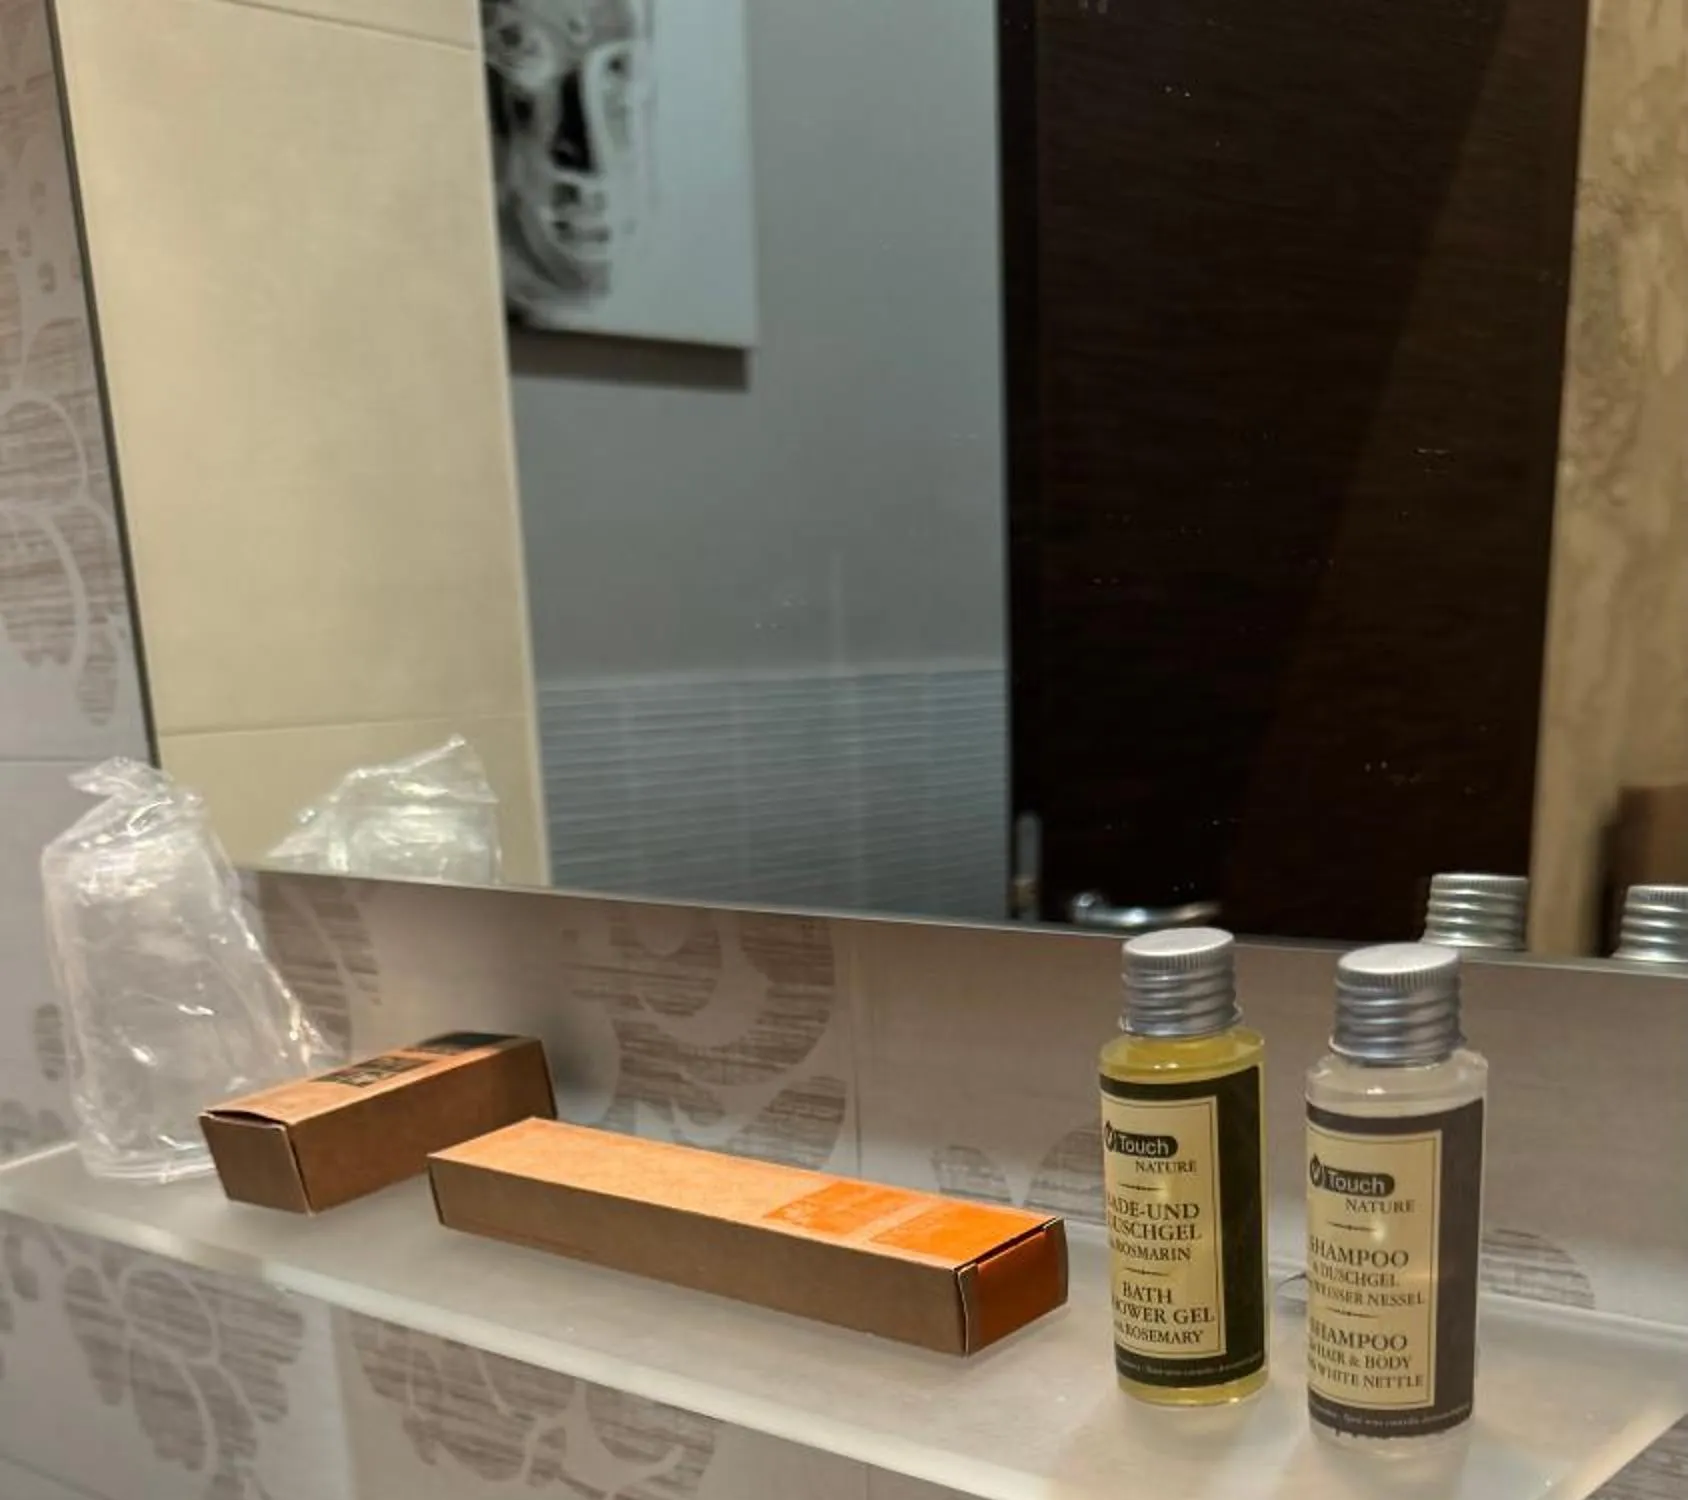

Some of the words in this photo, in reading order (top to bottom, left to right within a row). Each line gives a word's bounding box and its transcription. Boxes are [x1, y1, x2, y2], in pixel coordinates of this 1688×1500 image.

[1118, 1133, 1170, 1156] Touch
[1134, 1160, 1198, 1175] NATURE
[1326, 1169, 1387, 1195] Touch
[1345, 1199, 1416, 1215] NATURE
[1309, 1234, 1411, 1269] SHAMPOO
[1122, 1280, 1173, 1305] BATH
[1366, 1291, 1426, 1308] NESSEL
[1173, 1306, 1216, 1325] GEL
[1364, 1354, 1412, 1370] BODY
[1363, 1374, 1425, 1389] NETTLE
